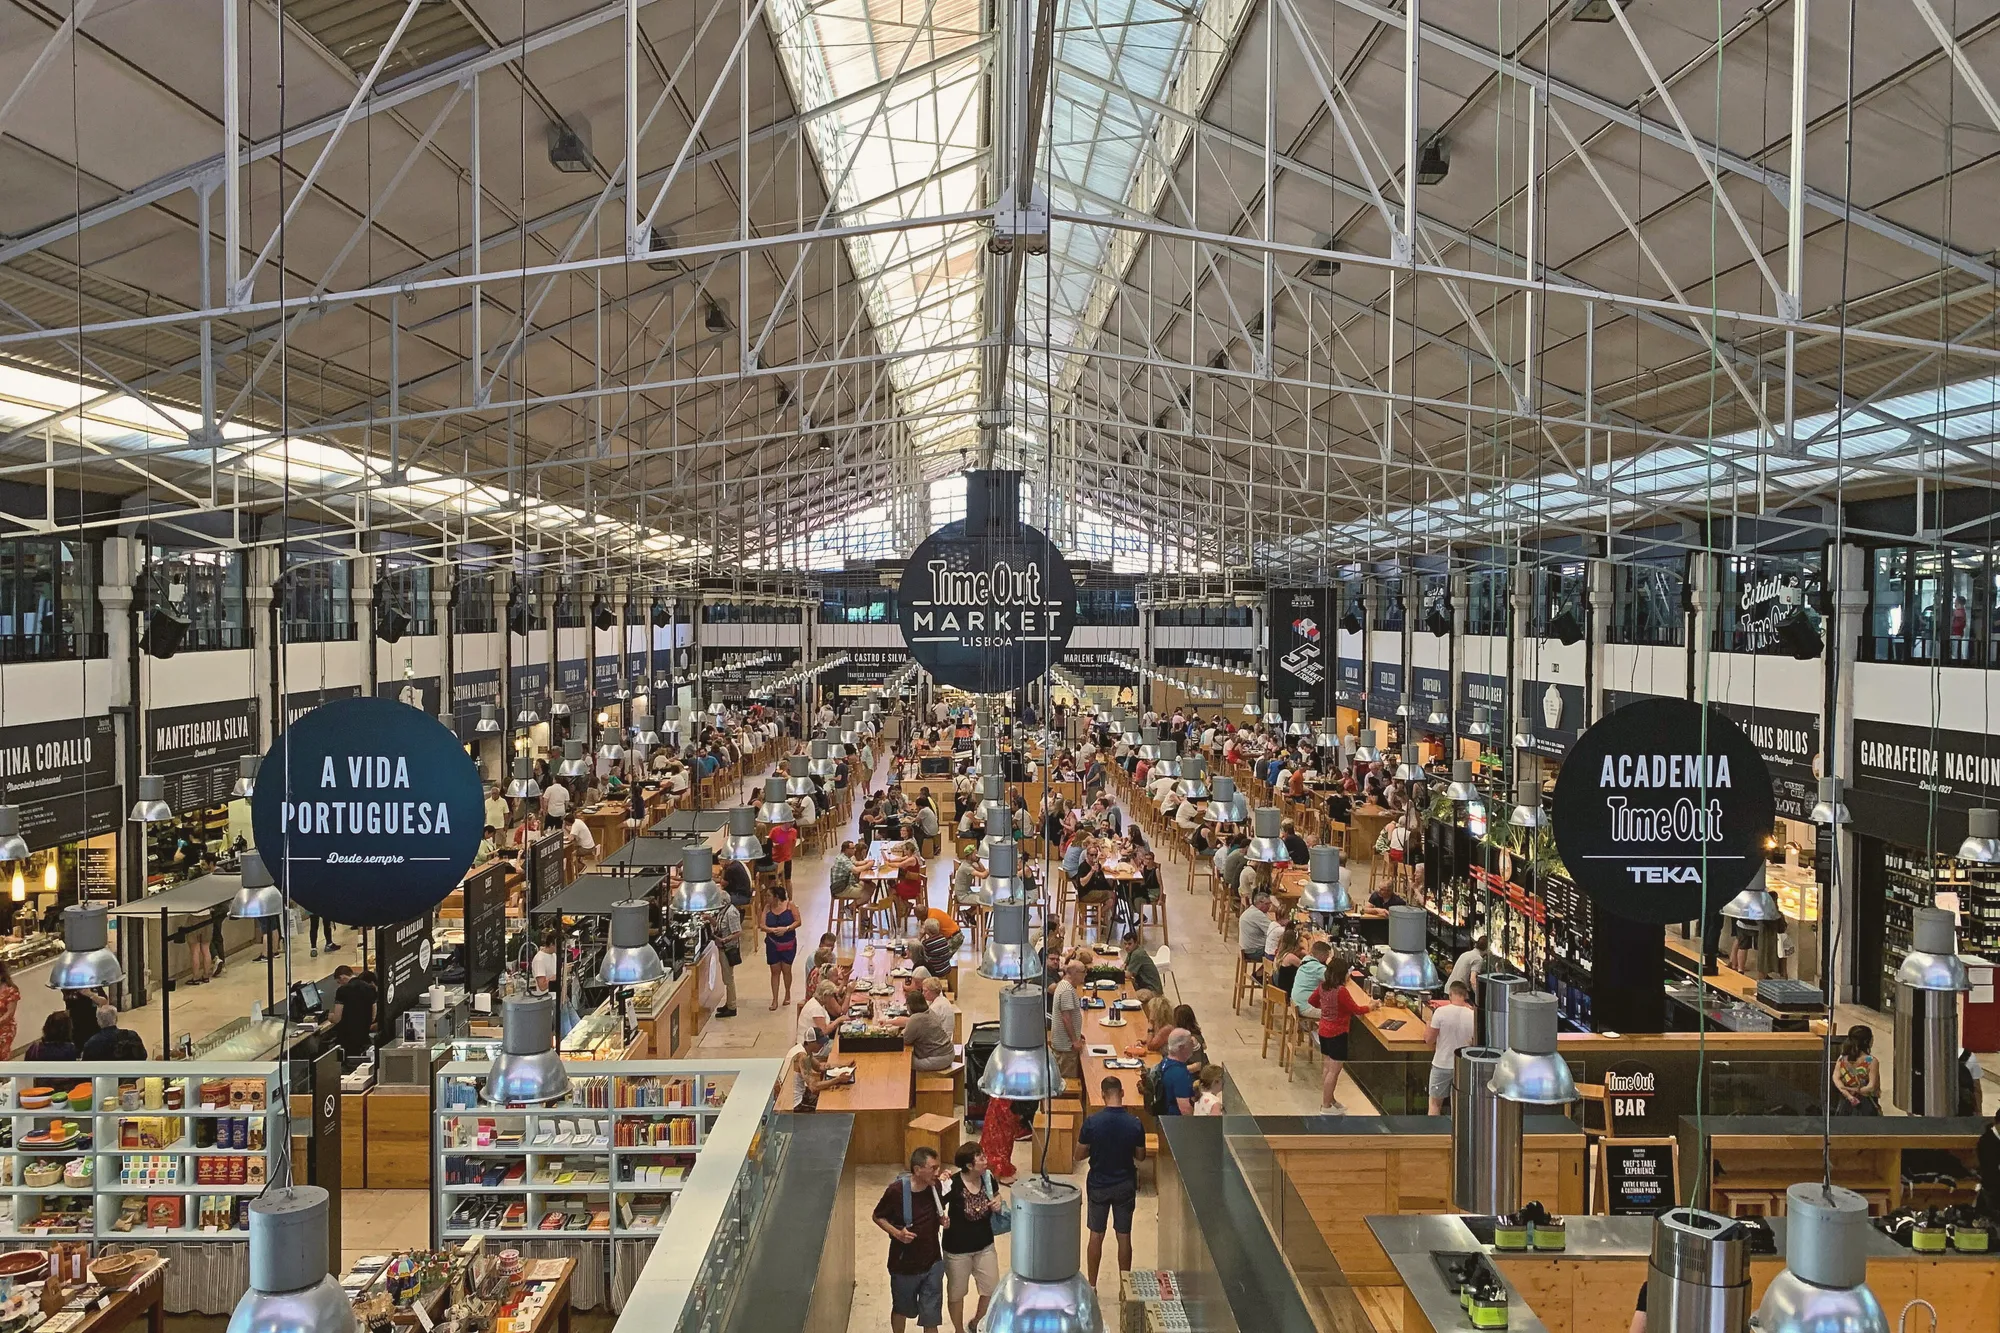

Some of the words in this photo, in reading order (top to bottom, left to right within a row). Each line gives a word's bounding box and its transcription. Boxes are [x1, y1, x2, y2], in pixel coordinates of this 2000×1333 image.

[1741, 573, 1785, 610] Estúdi
[913, 611, 1061, 632] MARKET
[962, 637, 1013, 647] LISBOA
[854, 653, 880, 662] CASTRO
[882, 653, 886, 662] E
[887, 653, 907, 662] SILVA
[1063, 653, 1094, 663] MARLENE
[1294, 670, 1316, 686] LISBOA
[156, 719, 222, 752] MANTEIGARIA
[224, 715, 249, 741] SILVA
[1750, 724, 1773, 749] MAIS
[1776, 728, 1808, 755] BOLOS
[36, 737, 92, 771] CORALLO
[1860, 740, 1938, 776] GARRAFEIRA
[320, 756, 337, 788] A
[347, 756, 410, 789] VIDA
[1599, 754, 1732, 788] ACADEMIA
[281, 802, 451, 834] PORTUGUESA
[1607, 796, 1672, 841] Time
[1673, 797, 1723, 841] Out
[326, 852, 362, 864] Desde
[363, 853, 405, 865] sempre
[1626, 866, 1702, 883] TEKA
[1614, 1098, 1646, 1117] BAR
[1625, 1167, 1655, 1175] EXPERIENCE
[1640, 1159, 1656, 1168] TABLE
